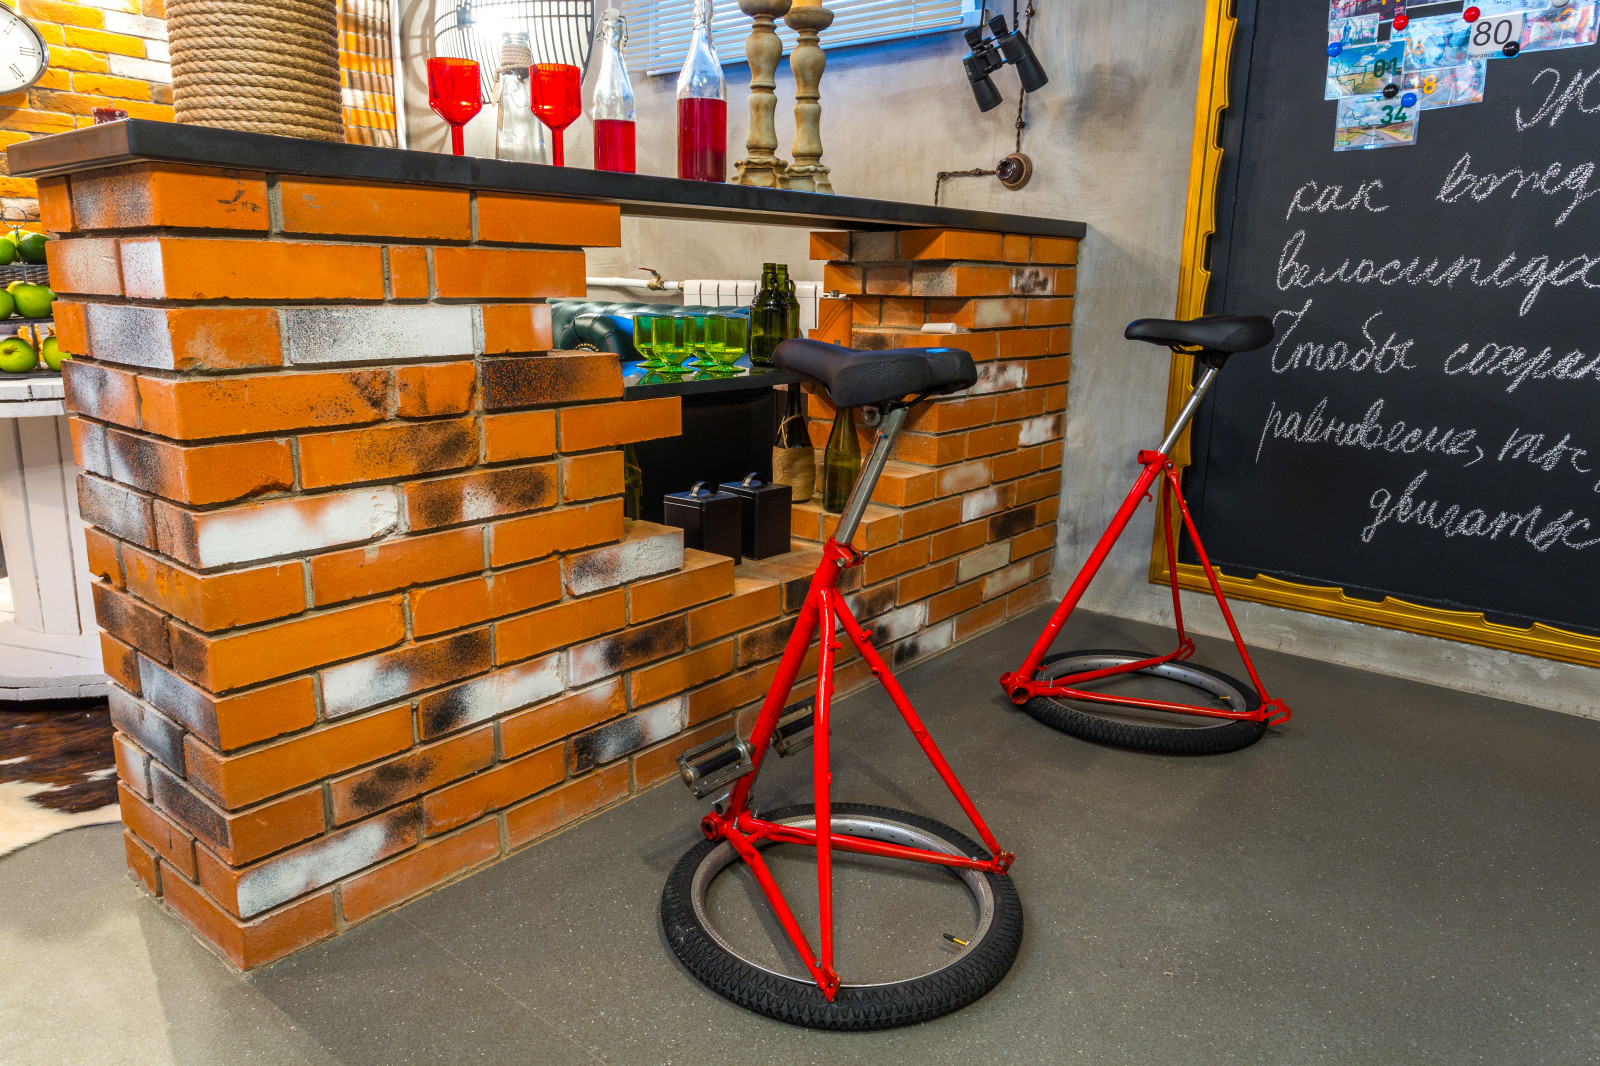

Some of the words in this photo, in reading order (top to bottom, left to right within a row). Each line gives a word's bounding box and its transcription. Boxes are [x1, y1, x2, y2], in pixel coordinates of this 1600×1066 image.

[1473, 19, 1513, 47] 80
[1374, 57, 1398, 79] 01
[1411, 75, 1438, 94] 18
[1380, 105, 1407, 125] 34
[1271, 299, 1417, 374] Чтобы
